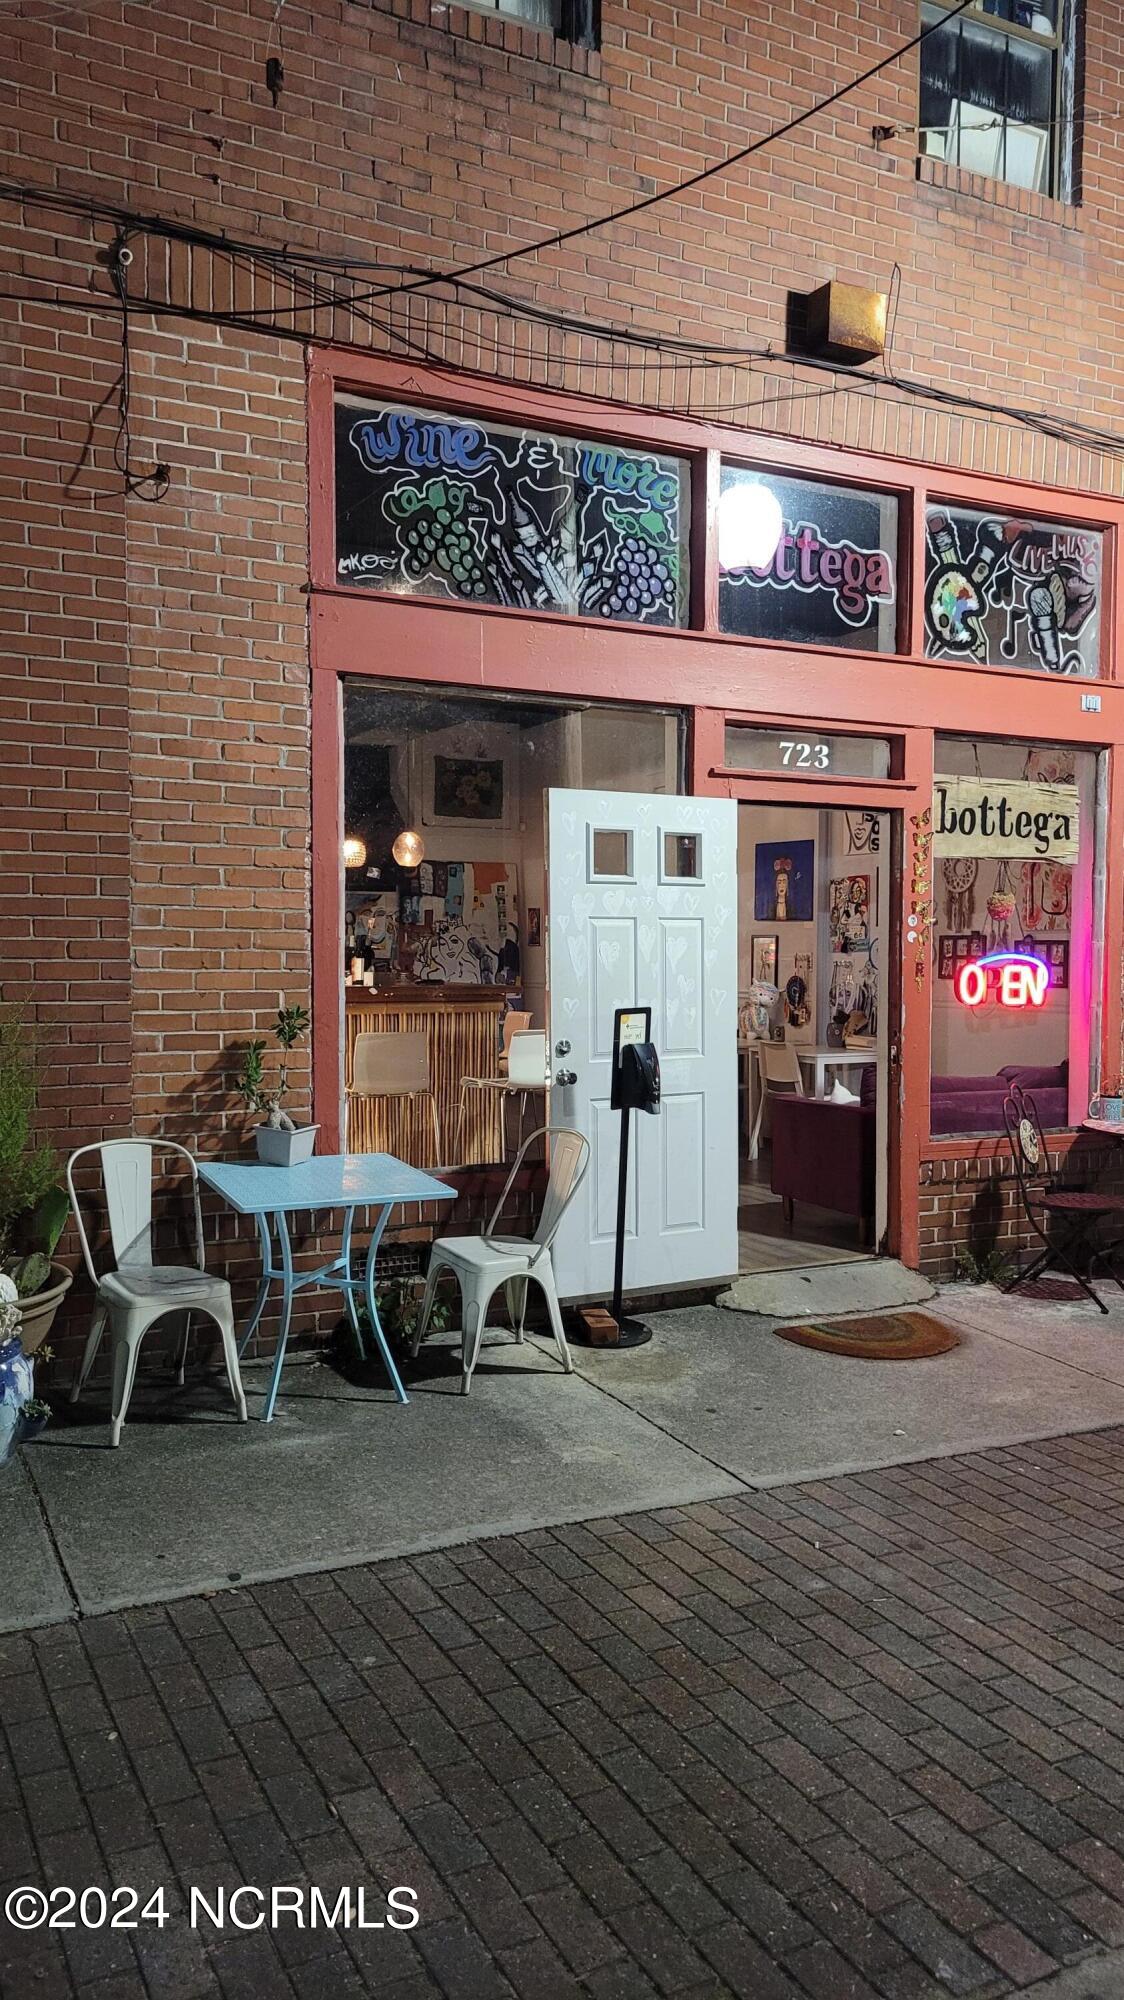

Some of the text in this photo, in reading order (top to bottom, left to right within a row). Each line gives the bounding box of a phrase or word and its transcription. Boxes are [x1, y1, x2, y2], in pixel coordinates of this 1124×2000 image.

[361, 414, 497, 470] Wine
[719, 528, 890, 614] ttega
[779, 742, 829, 768] 723
[935, 788, 1071, 853] bottega
[955, 963, 1048, 1007] OPEN
